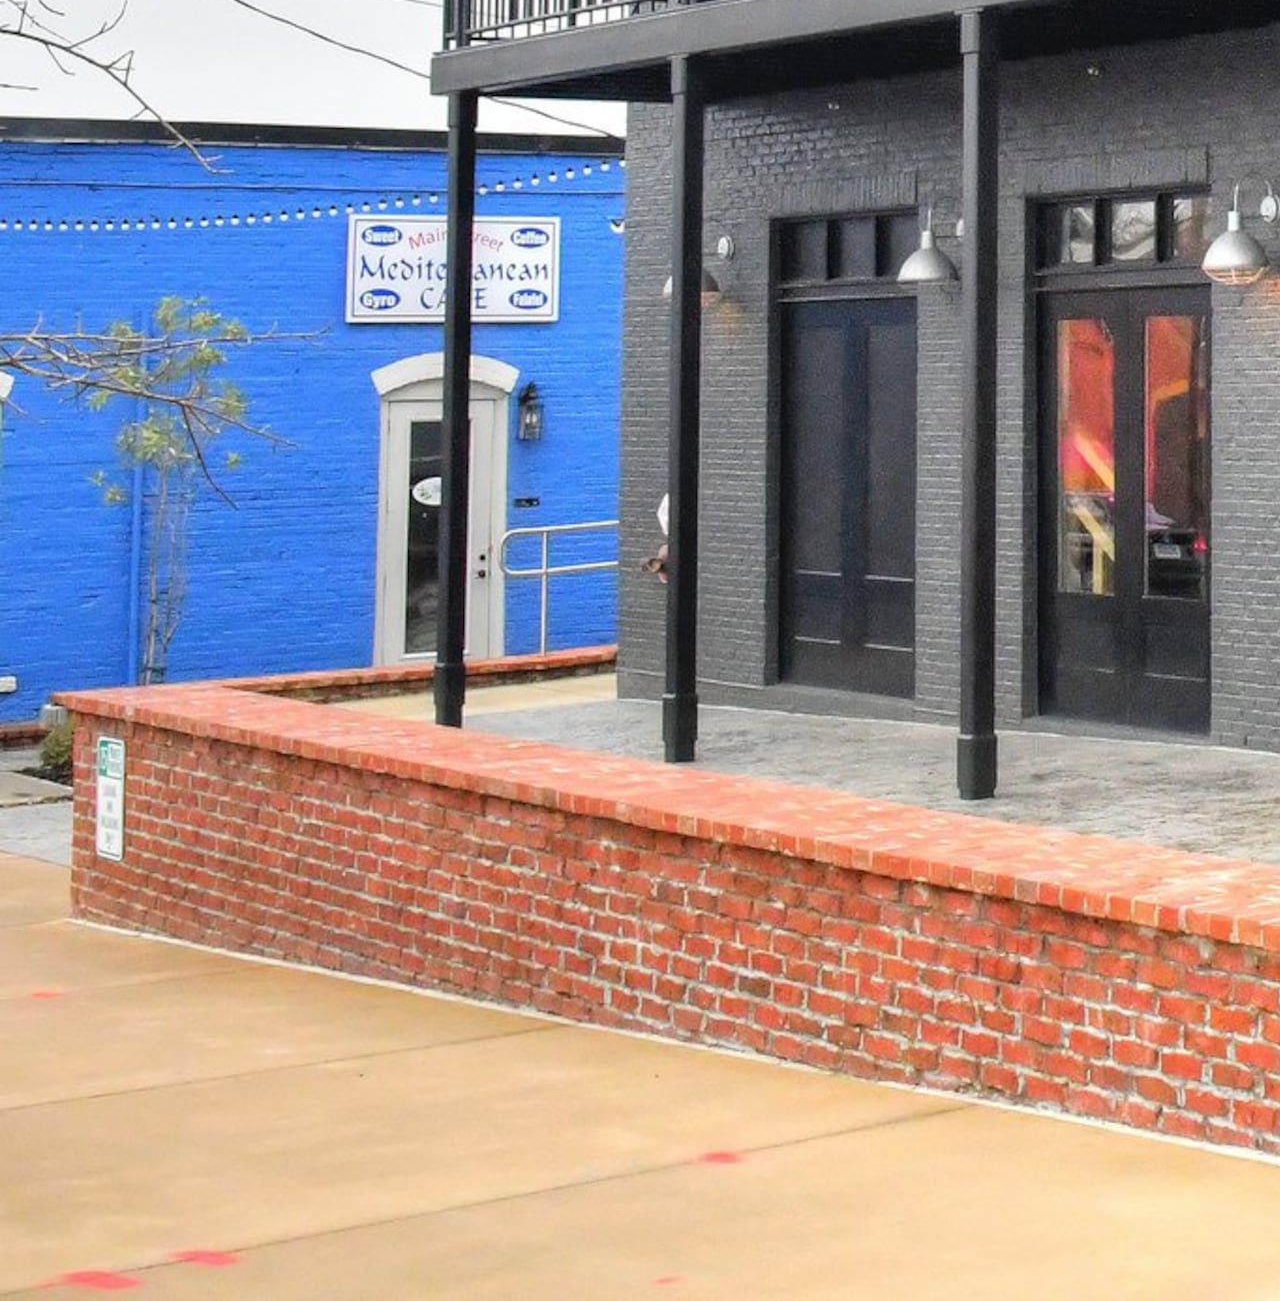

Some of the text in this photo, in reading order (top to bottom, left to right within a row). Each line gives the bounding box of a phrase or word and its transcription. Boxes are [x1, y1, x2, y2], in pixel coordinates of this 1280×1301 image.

[360, 254, 549, 281] Mediteanean
[362, 292, 397, 312] Gyro
[419, 287, 489, 311] CAE
